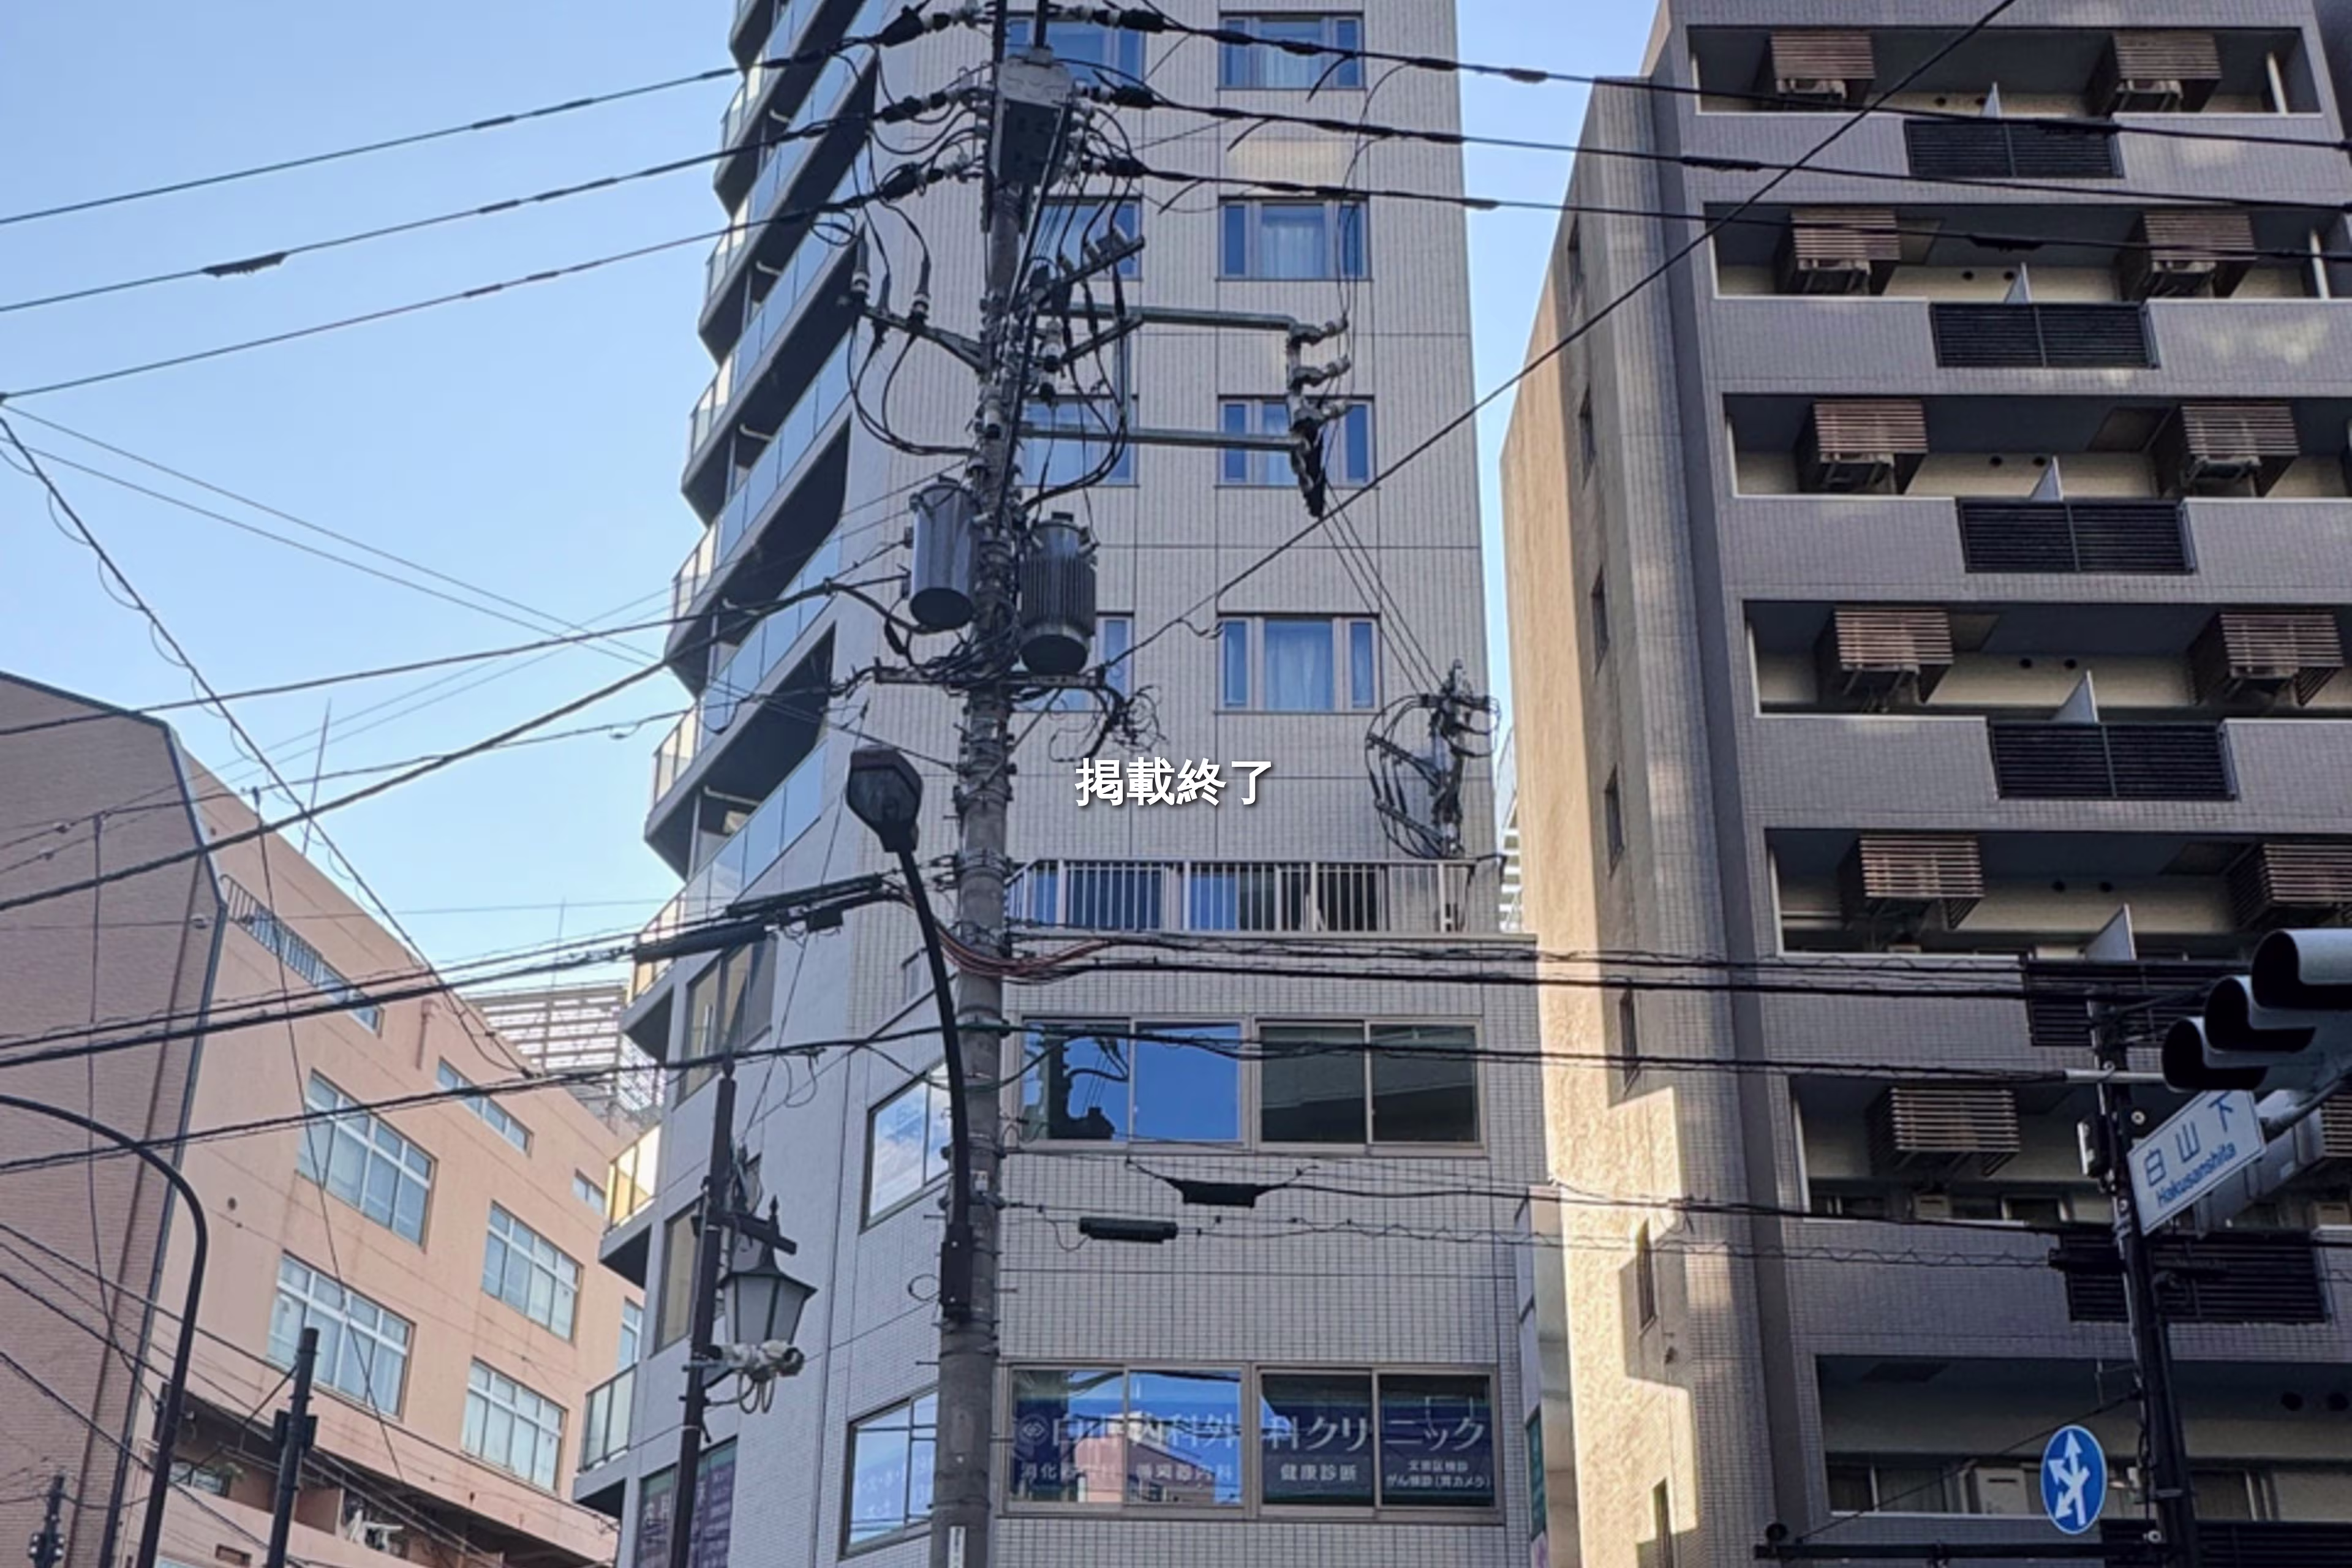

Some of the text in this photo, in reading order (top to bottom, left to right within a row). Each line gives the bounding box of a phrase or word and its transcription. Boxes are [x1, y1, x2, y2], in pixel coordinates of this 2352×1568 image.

[2144, 1091, 2233, 1186] 白山下
[2156, 1142, 2236, 1207] Hakusanshita
[1280, 1463, 1358, 1482] 健康診断
